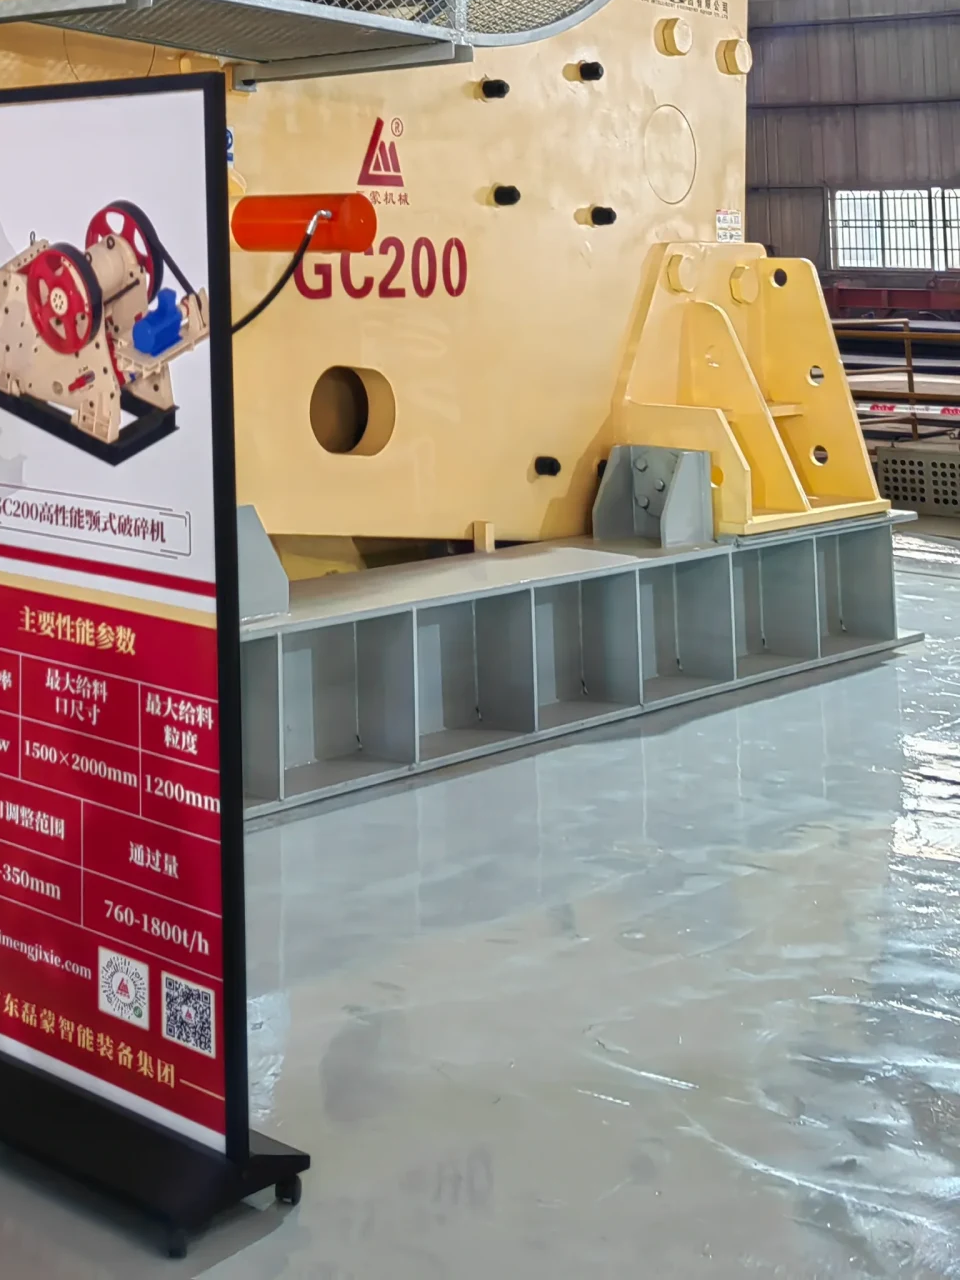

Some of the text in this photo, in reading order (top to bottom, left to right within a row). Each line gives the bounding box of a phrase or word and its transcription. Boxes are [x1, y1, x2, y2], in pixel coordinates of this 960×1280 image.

[356, 190, 410, 206] 蒙机械
[293, 236, 468, 300] GC200
[17, 605, 136, 656] 主要性能参数
[45, 667, 108, 703] 最大给料
[55, 698, 101, 726] 口尺寸
[145, 692, 214, 730] 最大给料
[163, 725, 198, 755] 粒度
[24, 739, 138, 788] 1500×2000mm
[145, 774, 221, 814] 1200mm
[128, 841, 179, 879] 通过量
[103, 899, 210, 955] 760-1800t/h
